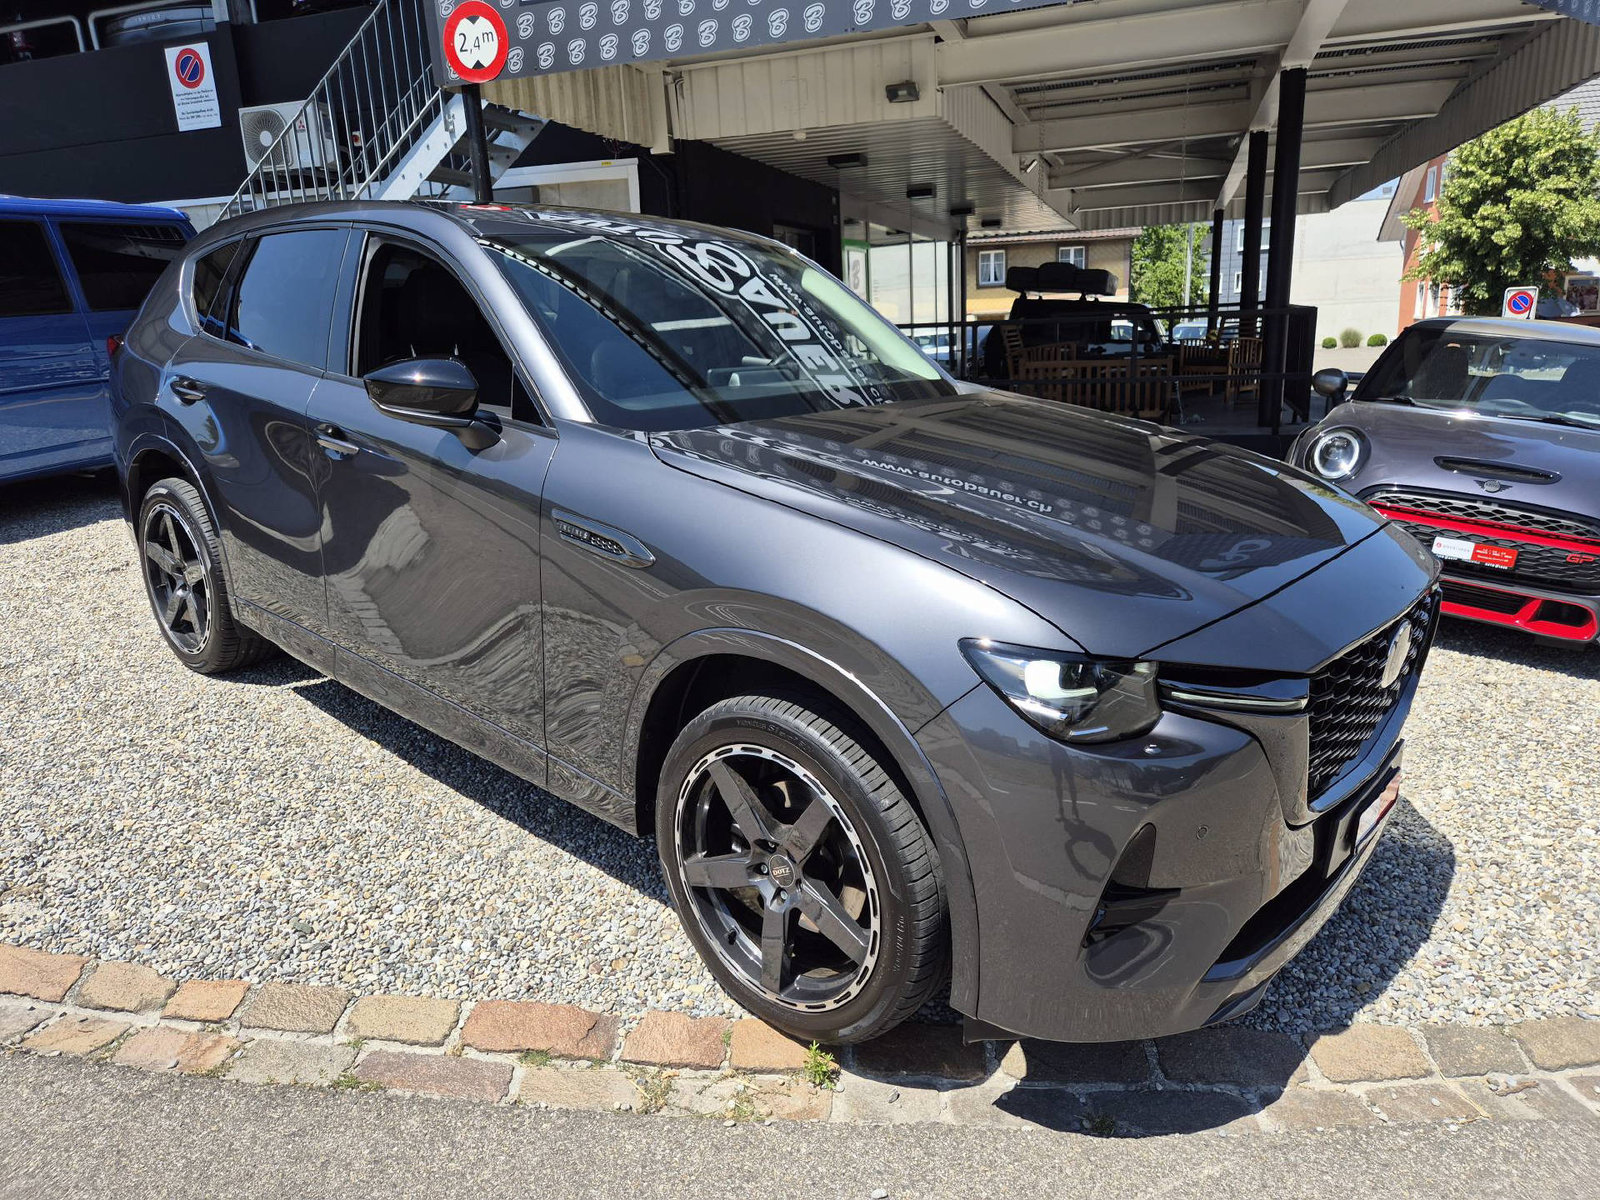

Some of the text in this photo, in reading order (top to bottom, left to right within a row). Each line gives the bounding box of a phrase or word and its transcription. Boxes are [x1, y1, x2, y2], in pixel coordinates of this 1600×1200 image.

[517, 12, 535, 39] B
[547, 7, 566, 35] B
[579, 2, 598, 30] B
[611, 0, 630, 25] B
[507, 46, 524, 73] B
[537, 42, 555, 69] B
[567, 38, 586, 65] B
[600, 33, 618, 60] B
[632, 28, 651, 56] B
[664, 24, 684, 52] B
[698, 19, 718, 47] B
[732, 14, 752, 42] B
[768, 8, 789, 38] B
[803, 3, 825, 32] B
[853, 0, 875, 25] B
[1566, 553, 1595, 564] GP
[772, 866, 791, 876] DOTZ
